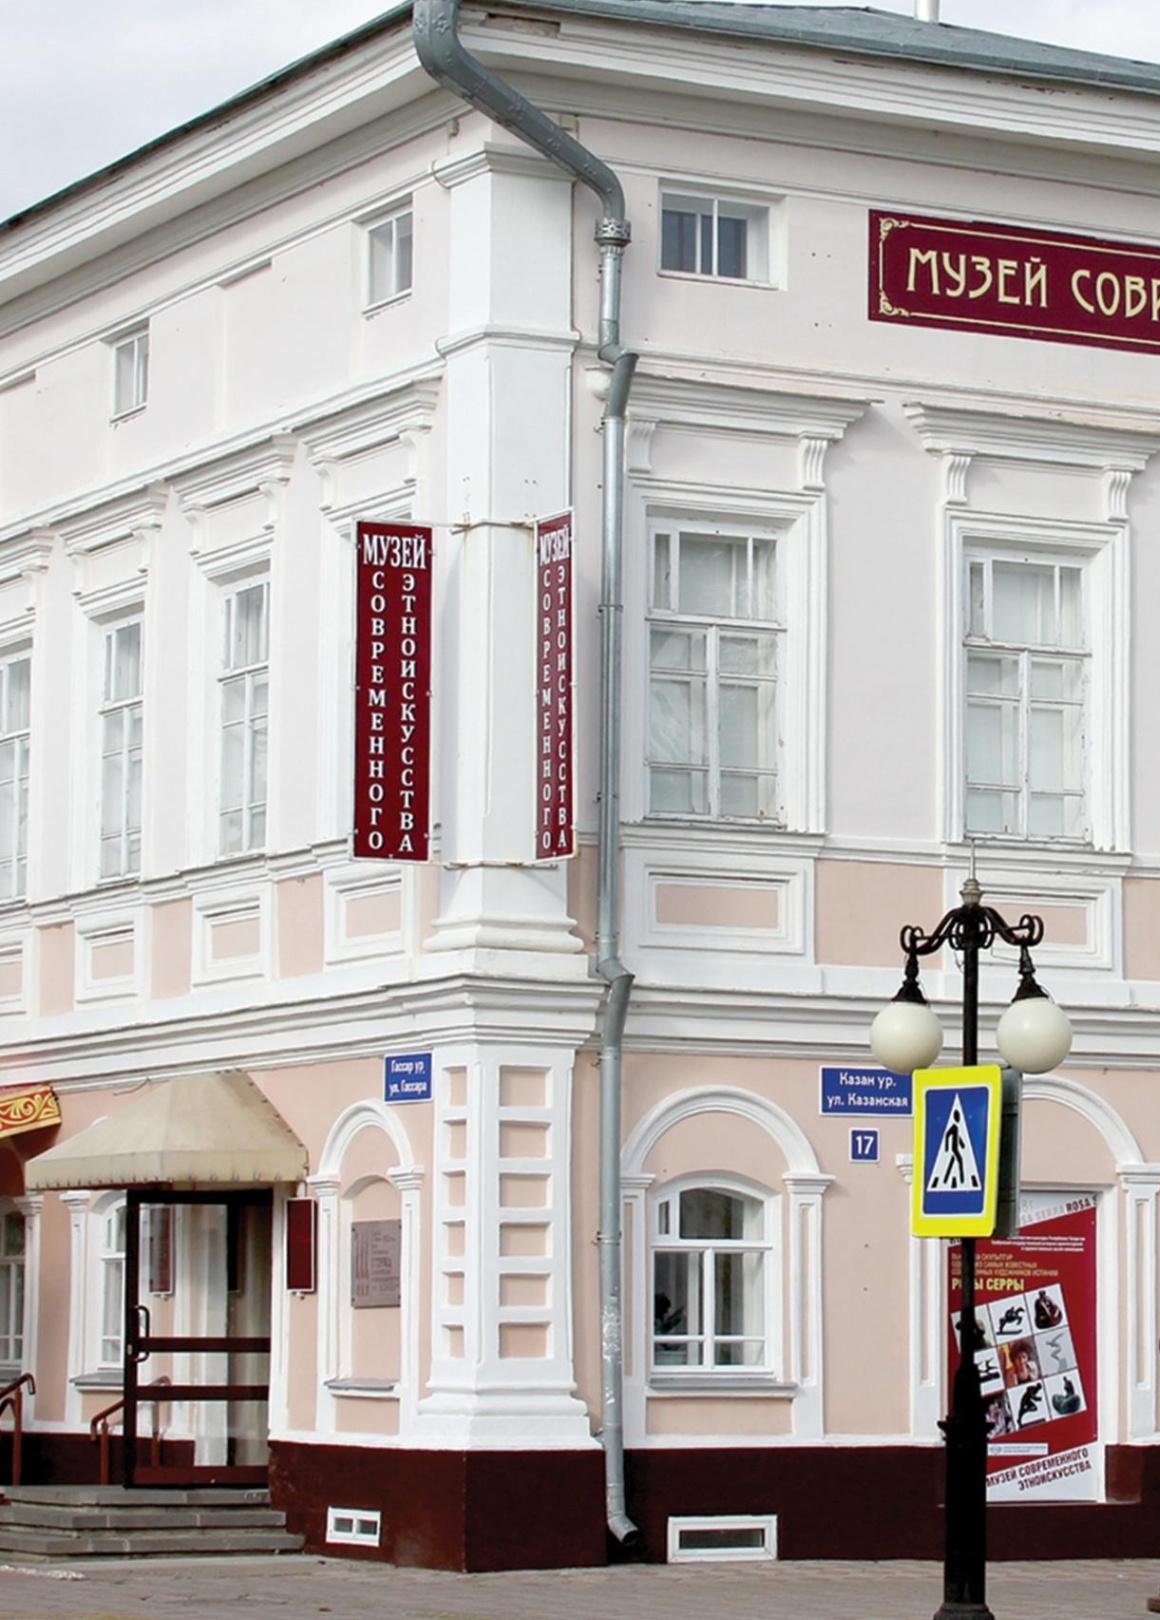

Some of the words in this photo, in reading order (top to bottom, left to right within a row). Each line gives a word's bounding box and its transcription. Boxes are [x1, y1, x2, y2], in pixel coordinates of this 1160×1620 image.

[906, 247, 1049, 309] МУЗЕЙ
[363, 534, 427, 569] МУЗЕЙ
[540, 525, 569, 566] МУЗЕЙ
[368, 571, 386, 850] СОВРЕМЕННОГО
[399, 573, 416, 852] ЭТНОИСКУССТВА
[542, 569, 552, 849] СОВРЕМЕННОГО
[557, 565, 567, 848] ЭТНОИСКУССТВА
[827, 1095, 845, 1109] ул.
[848, 1093, 909, 1107] Казанская
[839, 1072, 875, 1085] Казан
[877, 1076, 897, 1089] ур.
[856, 1135, 875, 1155] 17
